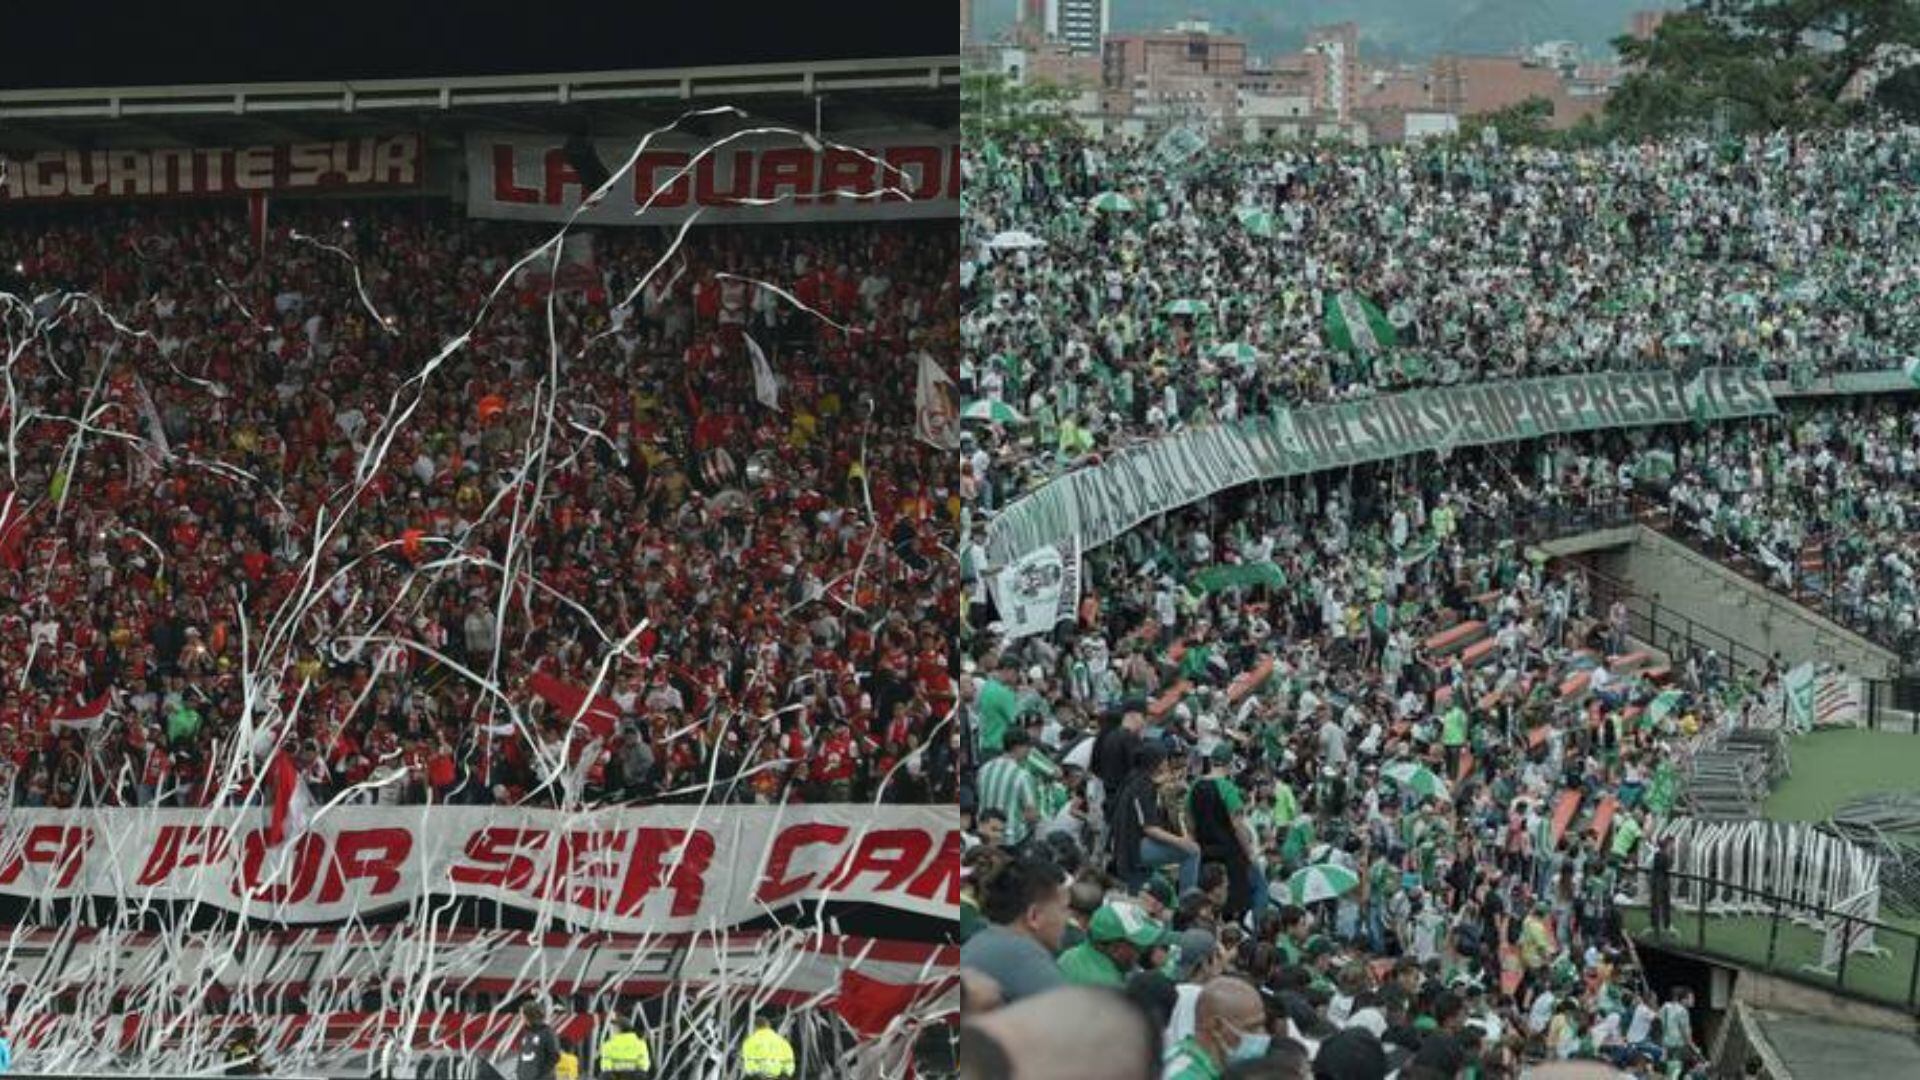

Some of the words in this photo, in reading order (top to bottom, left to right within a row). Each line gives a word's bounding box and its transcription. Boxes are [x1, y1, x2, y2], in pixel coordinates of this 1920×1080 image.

[289, 134, 418, 186] SUR
[1358, 394, 1434, 457] SUR
[136, 825, 414, 904] POR
[447, 826, 716, 918] SER
